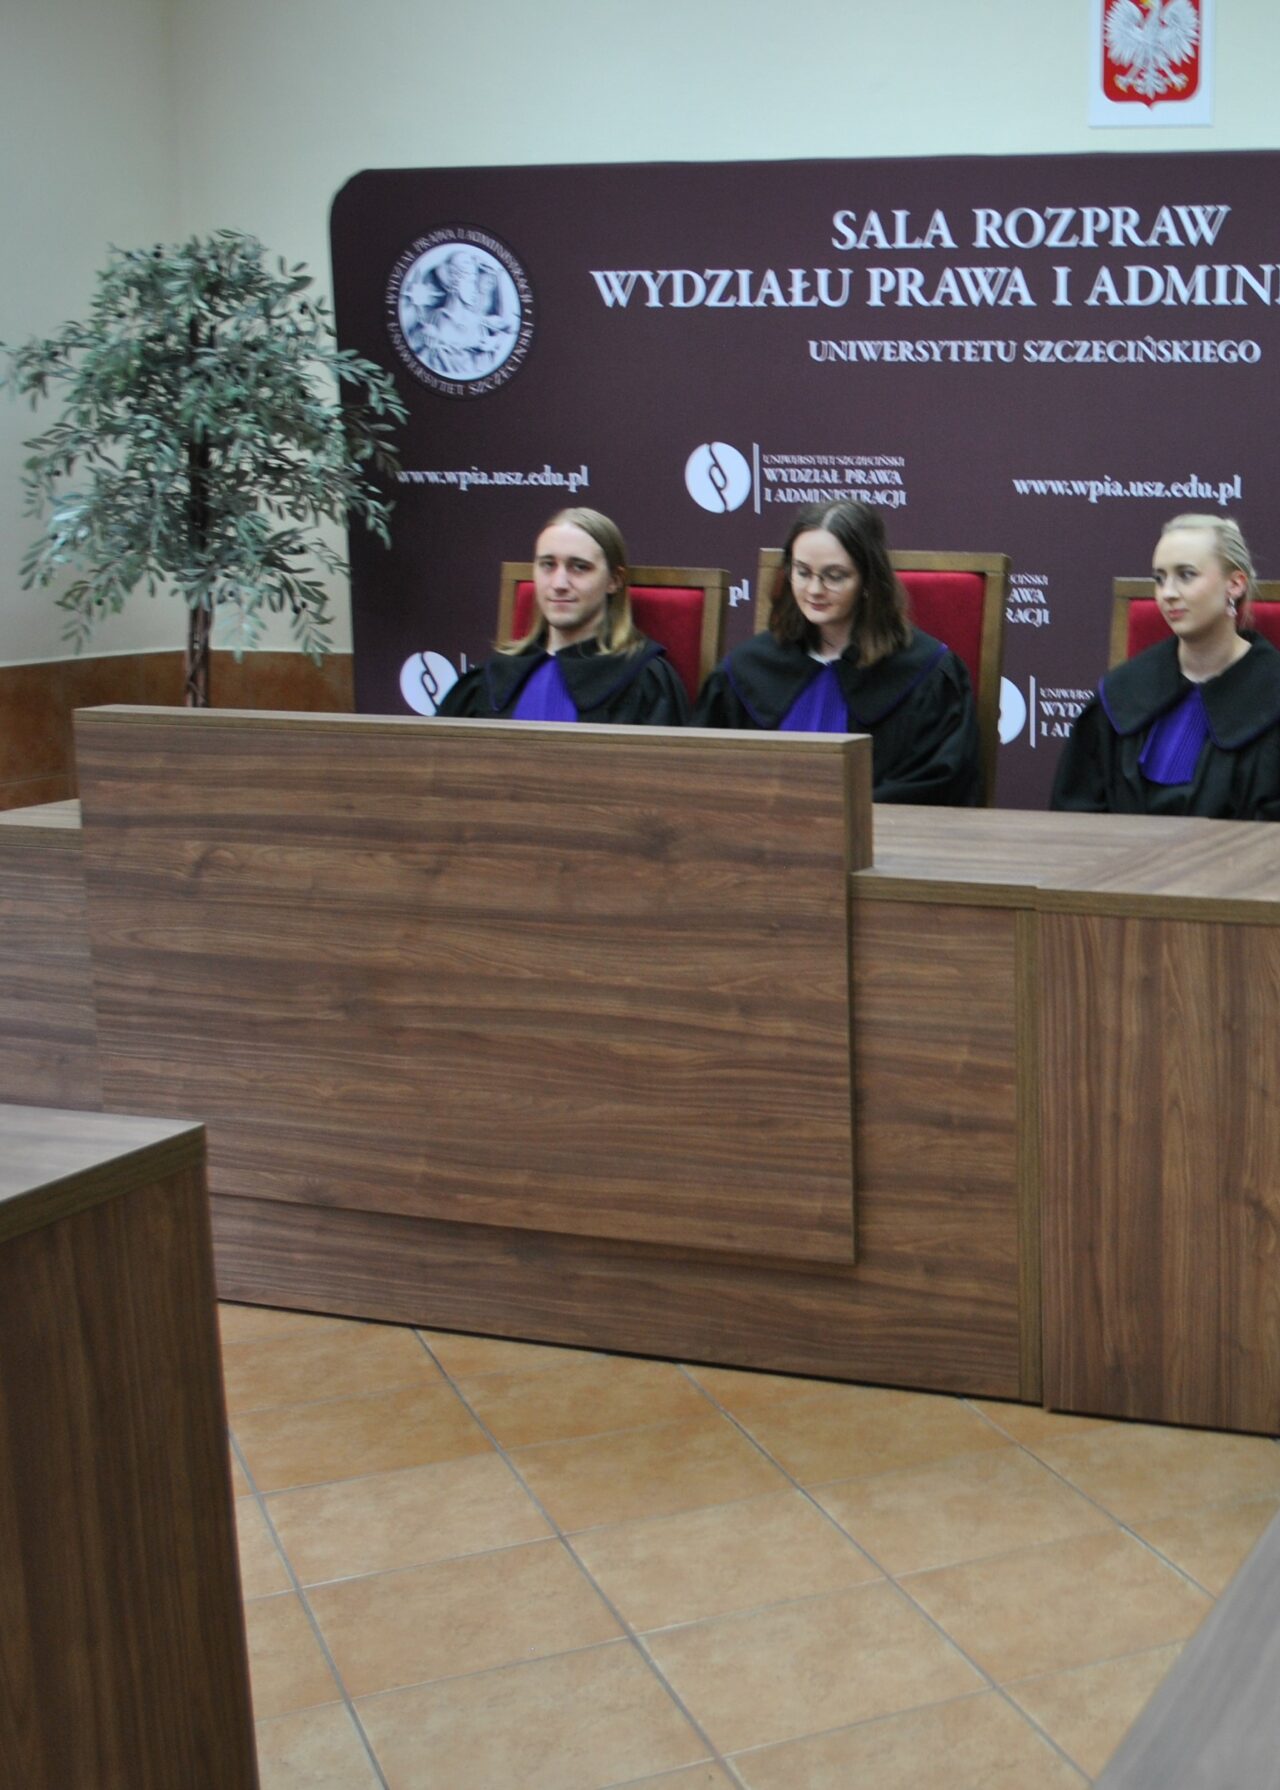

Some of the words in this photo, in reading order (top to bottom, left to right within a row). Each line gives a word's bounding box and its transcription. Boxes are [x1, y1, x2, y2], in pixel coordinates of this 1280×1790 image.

[831, 208, 959, 251] SALA
[972, 204, 1232, 250] ROZPRAW
[589, 268, 855, 308] WYDZIAŁU
[865, 266, 1038, 307] PRAWA
[1052, 266, 1073, 306] I
[808, 339, 1018, 363] UNIWERSYTETU
[1022, 334, 1263, 365] SZCZECIŃSKIEGO
[395, 464, 590, 493] www.wpia.usz.edu.pl
[762, 467, 842, 484] WYDZIAŁ
[844, 468, 904, 485] PRAWA
[1012, 473, 1242, 506] www.wpia.usz.edu.pl
[764, 487, 772, 502] I
[774, 488, 907, 509] ADMINISTRACJI
[1006, 587, 1047, 604] AWA
